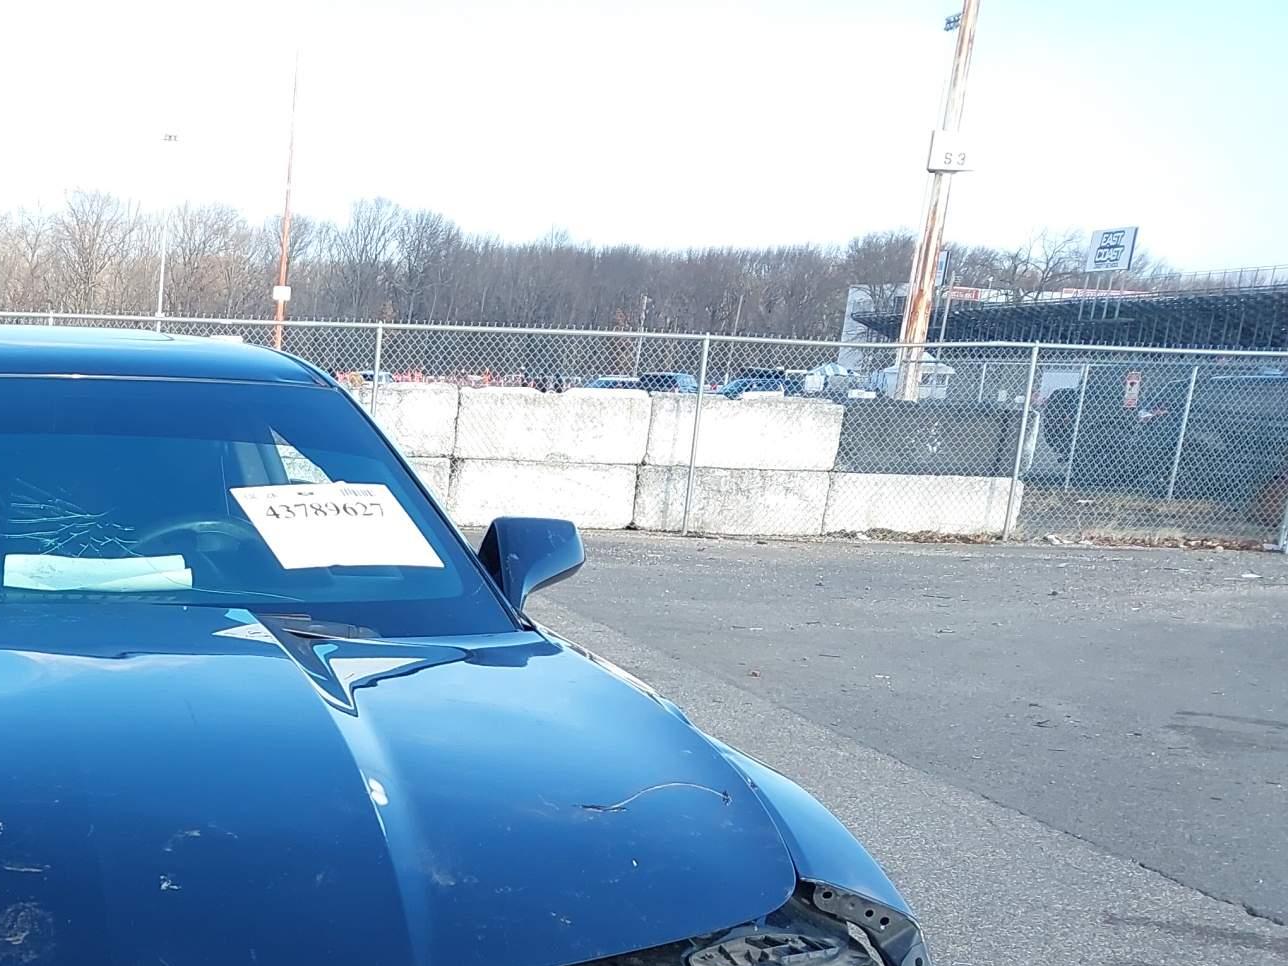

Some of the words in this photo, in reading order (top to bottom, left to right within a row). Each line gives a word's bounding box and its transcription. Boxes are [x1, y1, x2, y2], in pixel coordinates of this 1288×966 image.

[1100, 230, 1125, 247] EAST
[1094, 246, 1125, 263] COAST
[265, 502, 384, 519] 43789627
